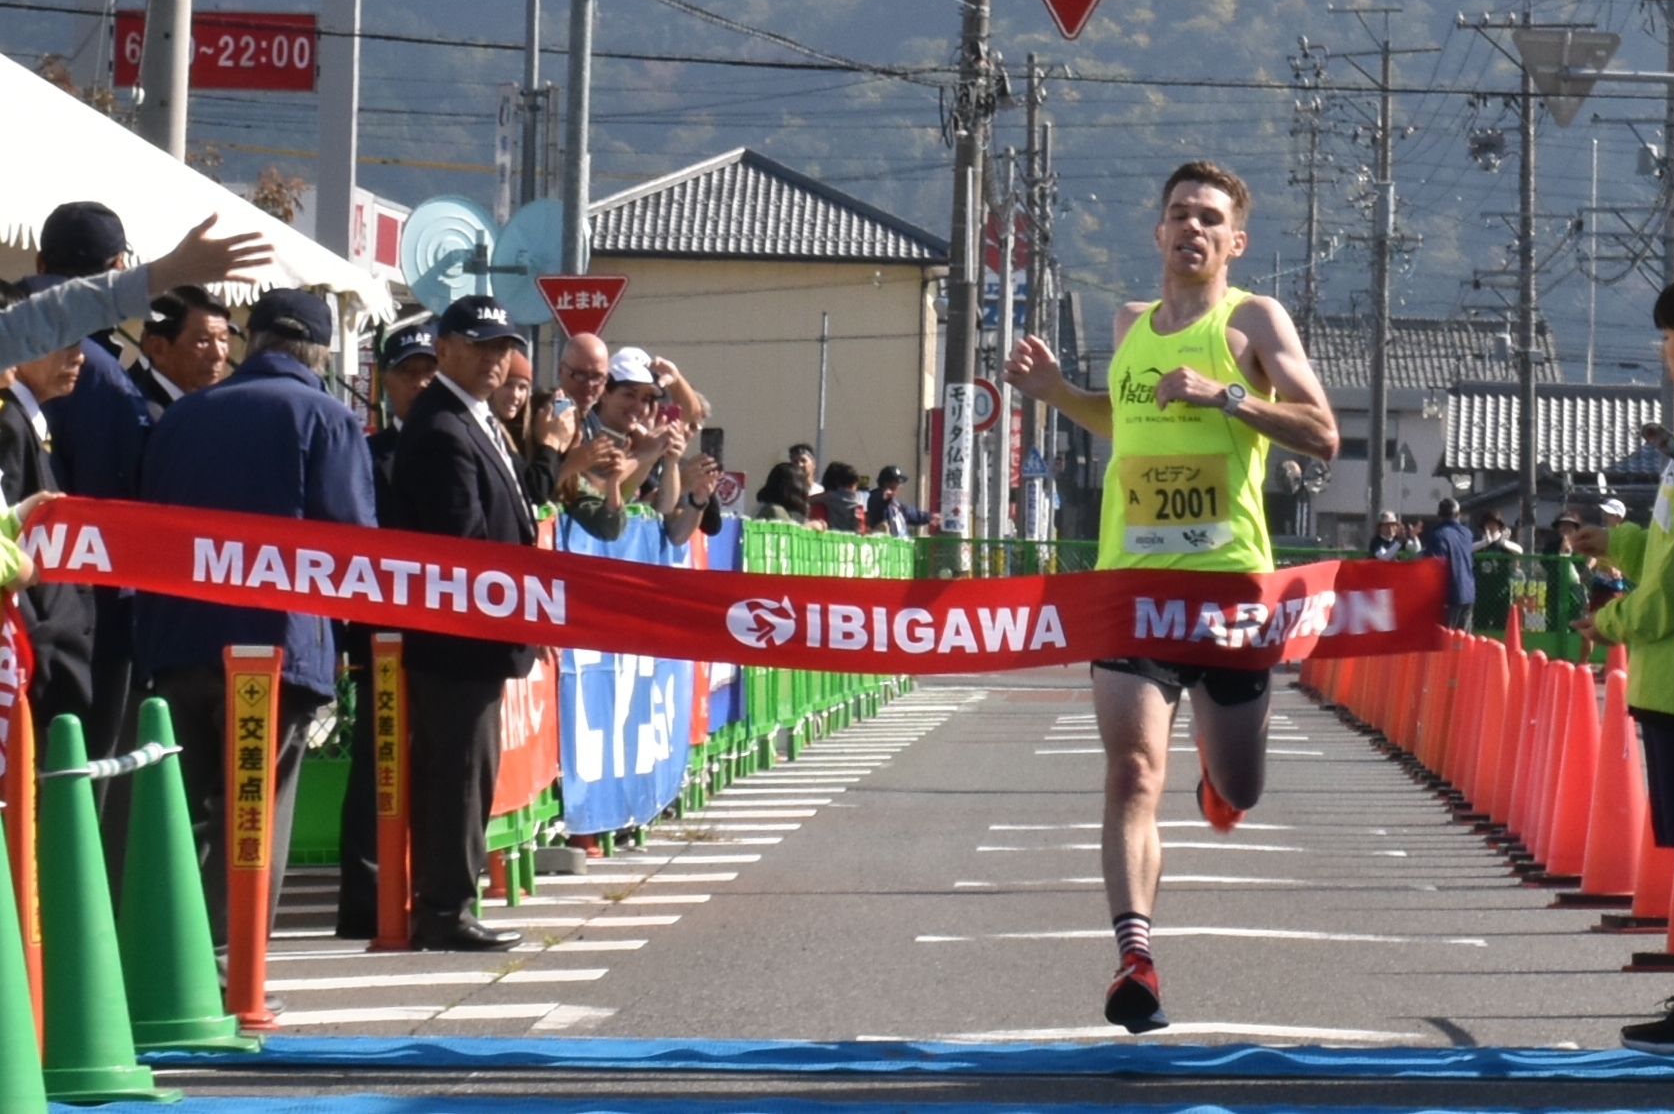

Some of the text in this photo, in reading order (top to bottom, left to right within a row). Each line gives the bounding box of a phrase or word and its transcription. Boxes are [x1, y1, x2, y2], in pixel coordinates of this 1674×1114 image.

[556, 291, 609, 310] 止まれ
[1129, 486, 1217, 520] A 2001
[1141, 465, 1201, 483] イビデン
[193, 537, 567, 625] MARATHON
[806, 602, 1068, 655] IBIGAWA
[1134, 588, 1397, 649] MARATHON
[237, 716, 265, 863] 交差点注意
[377, 689, 396, 814] 交差点注意
